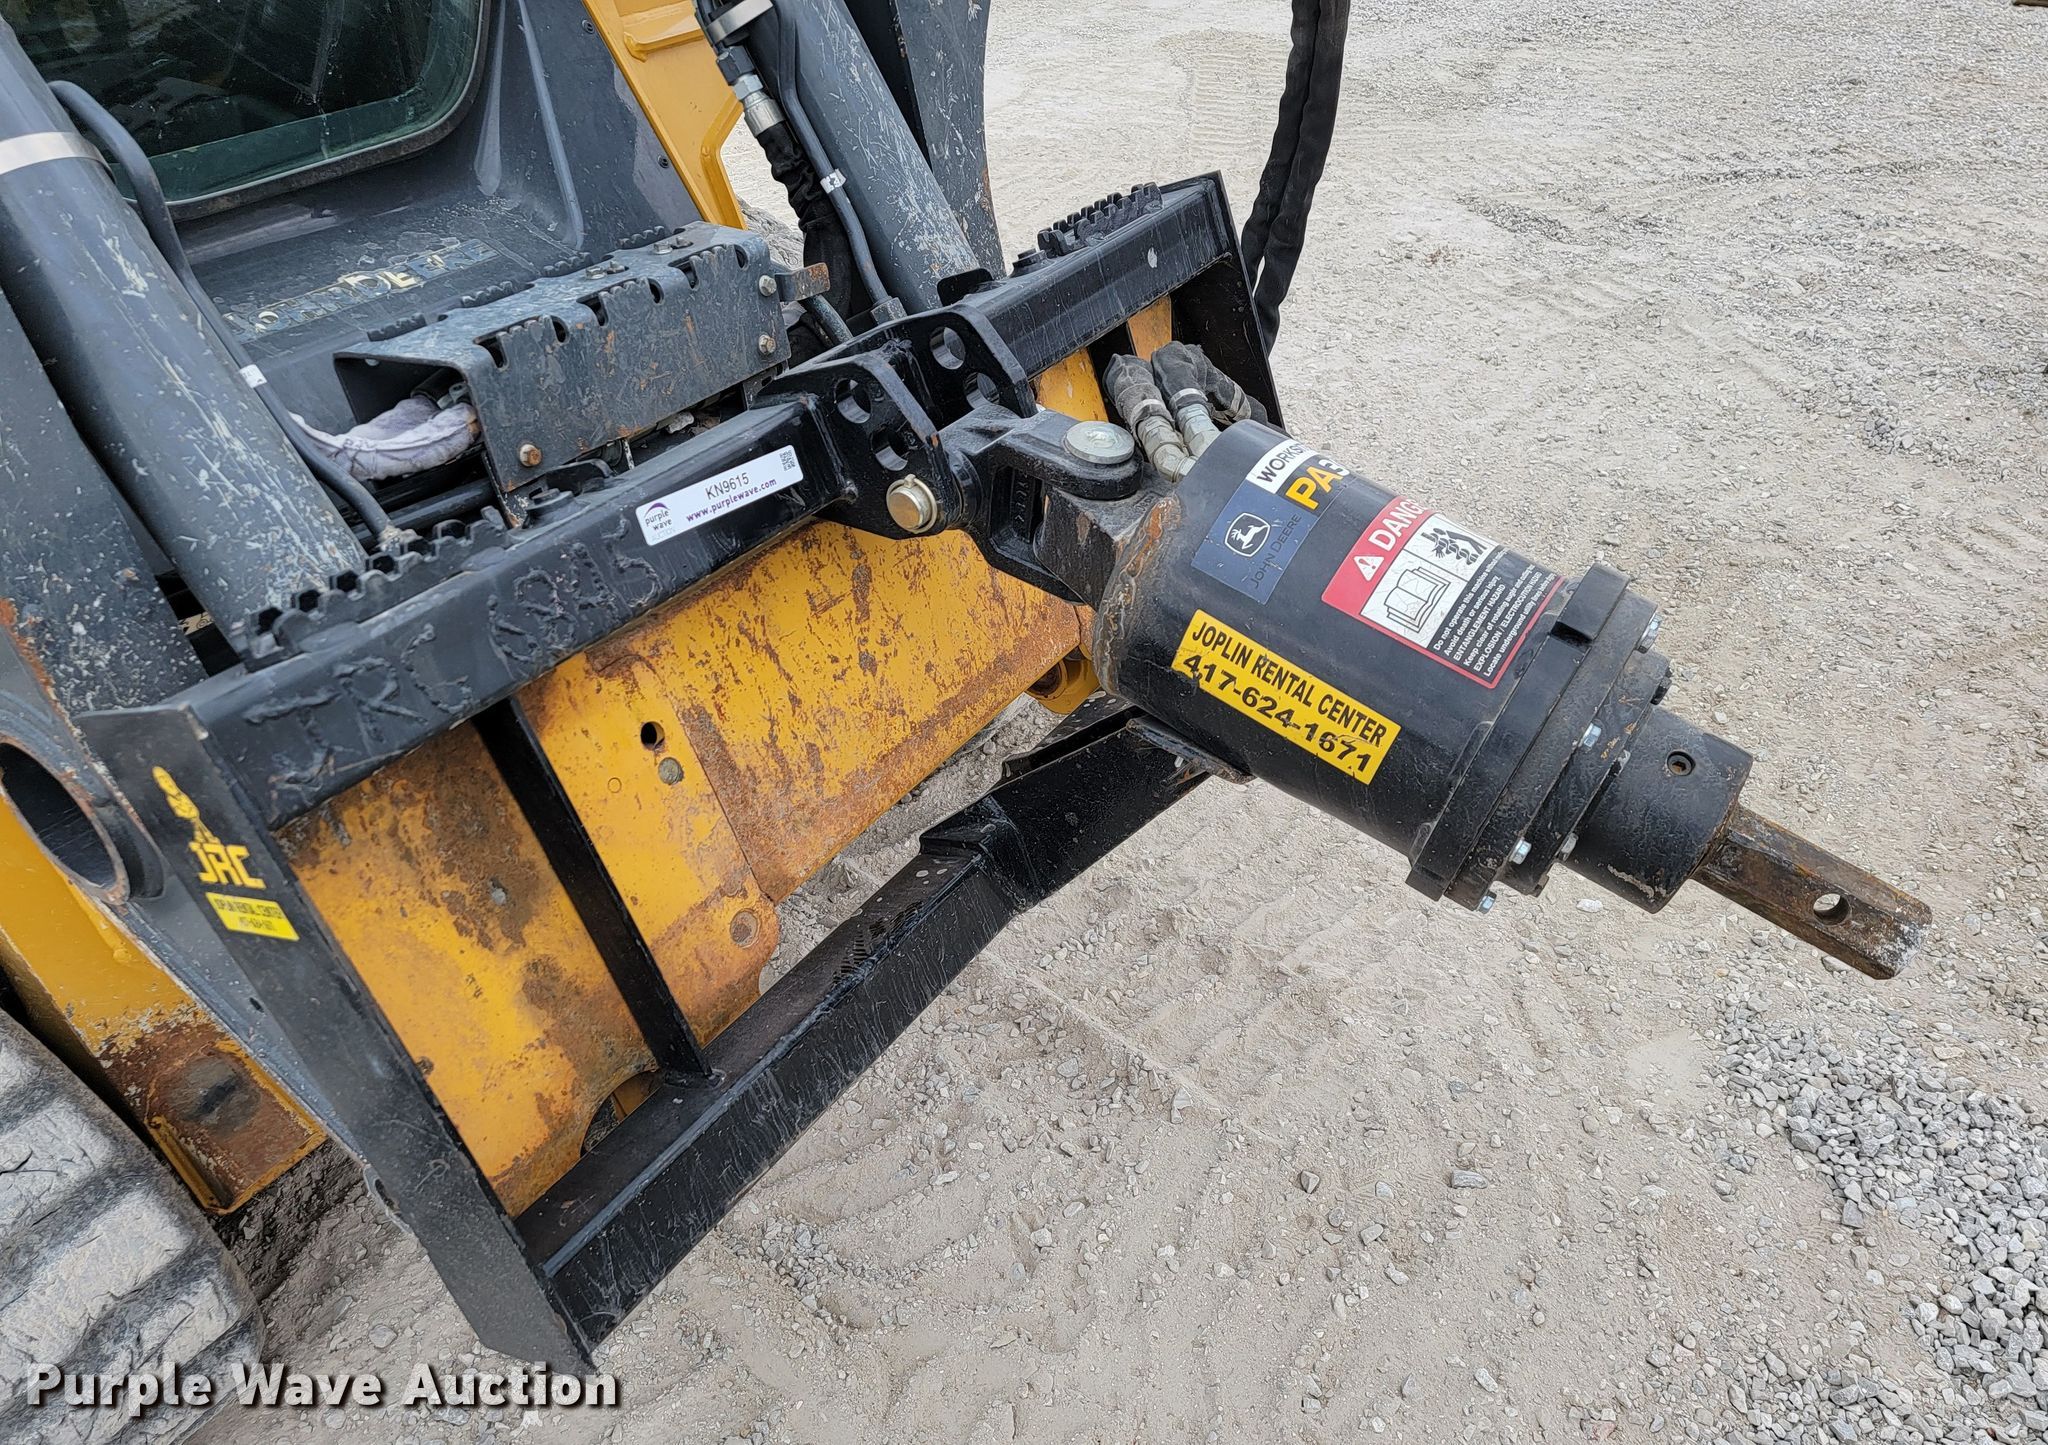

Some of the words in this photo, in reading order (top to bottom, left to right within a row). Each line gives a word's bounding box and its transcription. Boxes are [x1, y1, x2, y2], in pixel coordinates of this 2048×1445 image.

[645, 510, 669, 527] purple
[686, 478, 777, 522] www.purplewave.com
[705, 472, 750, 500] KN9615
[653, 519, 672, 531] wave
[1251, 553, 1277, 590] JOHN
[1271, 514, 1302, 554] DEERE
[1433, 641, 1444, 652] Do
[1442, 627, 1452, 641] not
[1450, 603, 1467, 629] operate
[1464, 591, 1475, 605] this
[1472, 570, 1488, 593] machine
[1444, 634, 1460, 656] Avoid
[1457, 616, 1471, 636] death
[1474, 587, 1490, 610] serious
[1453, 605, 1492, 661] ENTANGLEMENT
[1489, 584, 1506, 609] HAZARD
[1464, 647, 1479, 667] Keep
[1476, 629, 1490, 649] clear
[1491, 600, 1510, 624] rotating
[1473, 630, 1504, 672] EXPLOSION
[1502, 585, 1534, 629] ELECTROCUTION
[1484, 652, 1503, 677] Locate
[1499, 614, 1527, 654] underground
[1182, 654, 1373, 774] 417-624-1671
[1191, 620, 1250, 670] JOPLIN
[1252, 650, 1313, 707] RENTAL
[1317, 694, 1387, 748] CENTER
[188, 842, 267, 890] JRC
